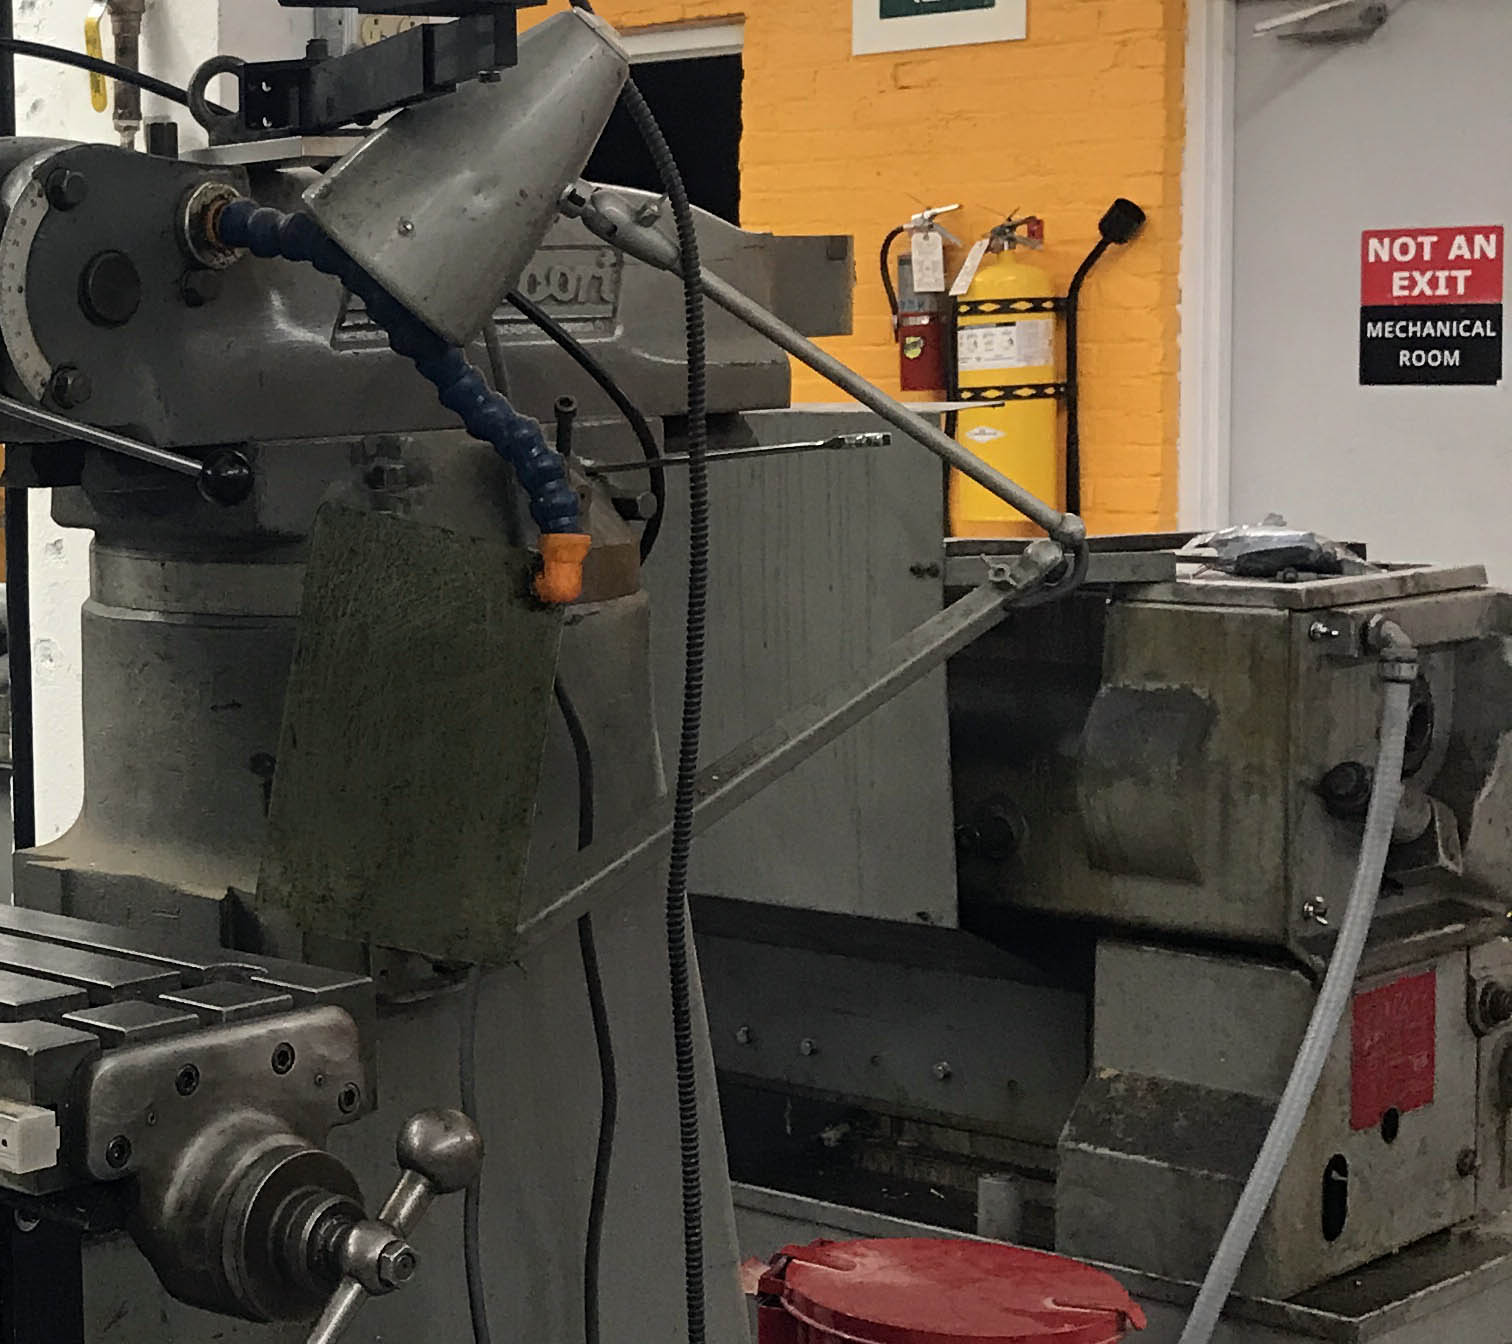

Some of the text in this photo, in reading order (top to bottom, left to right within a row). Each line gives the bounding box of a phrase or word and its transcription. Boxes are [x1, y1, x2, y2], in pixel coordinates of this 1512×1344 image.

[1368, 234, 1497, 263] NOT AN
[1392, 269, 1472, 297] EXIT
[1366, 319, 1497, 338] MECHANICAL
[1399, 350, 1460, 367] ROOM
